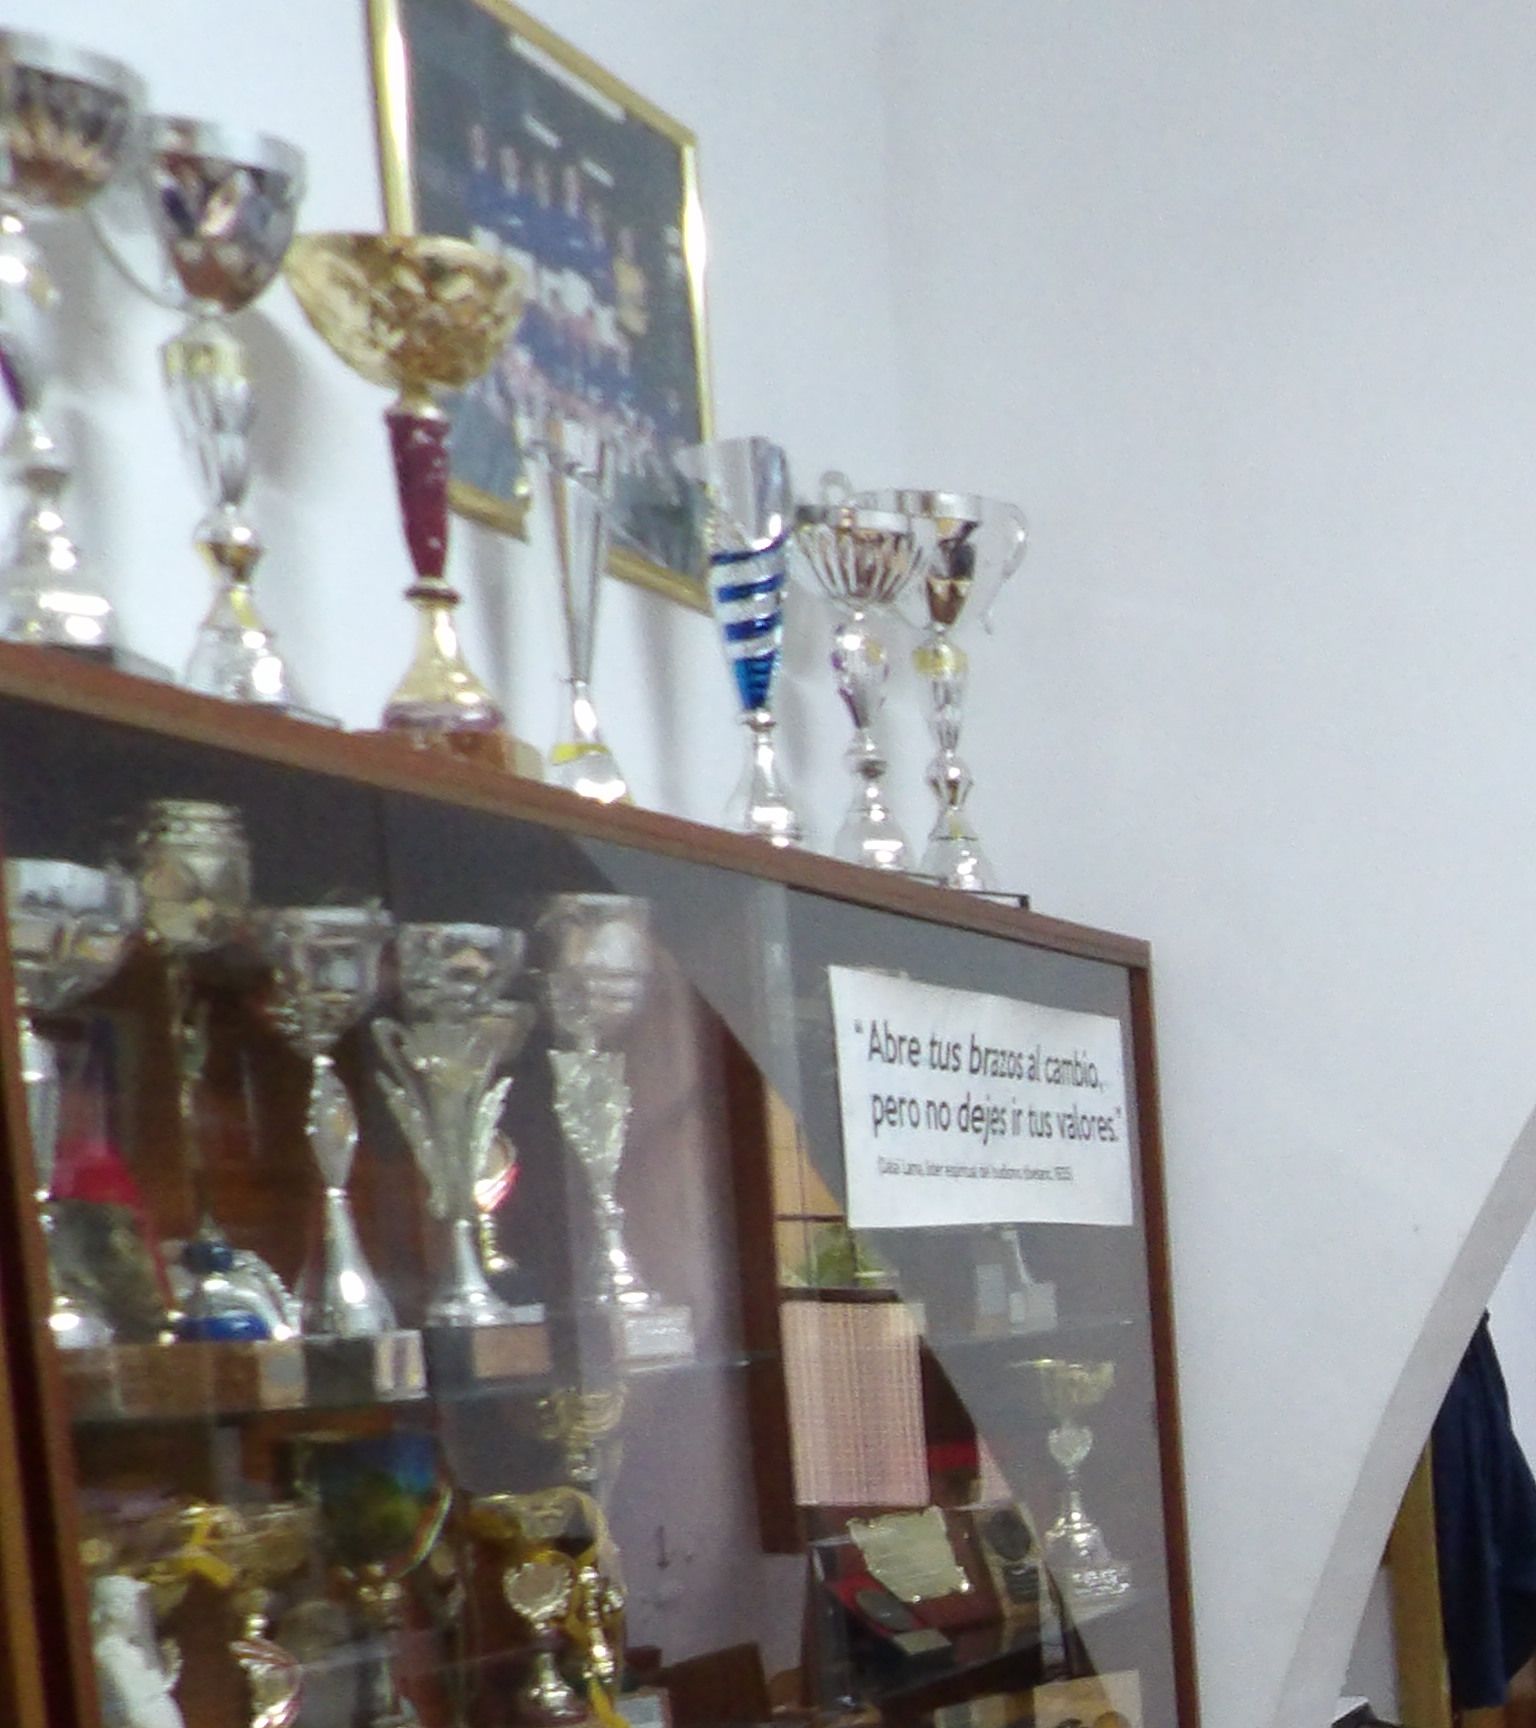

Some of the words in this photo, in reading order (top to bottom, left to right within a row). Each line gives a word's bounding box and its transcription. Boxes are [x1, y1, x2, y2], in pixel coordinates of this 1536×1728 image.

[929, 1033, 961, 1073] tus
[969, 1033, 1024, 1078] brazos
[1027, 1044, 1041, 1081] al
[871, 1093, 920, 1137] pero
[926, 1100, 951, 1131] no
[957, 1092, 1007, 1146] dejes
[1011, 1099, 1023, 1137] ir
[1028, 1109, 1053, 1138] tus
